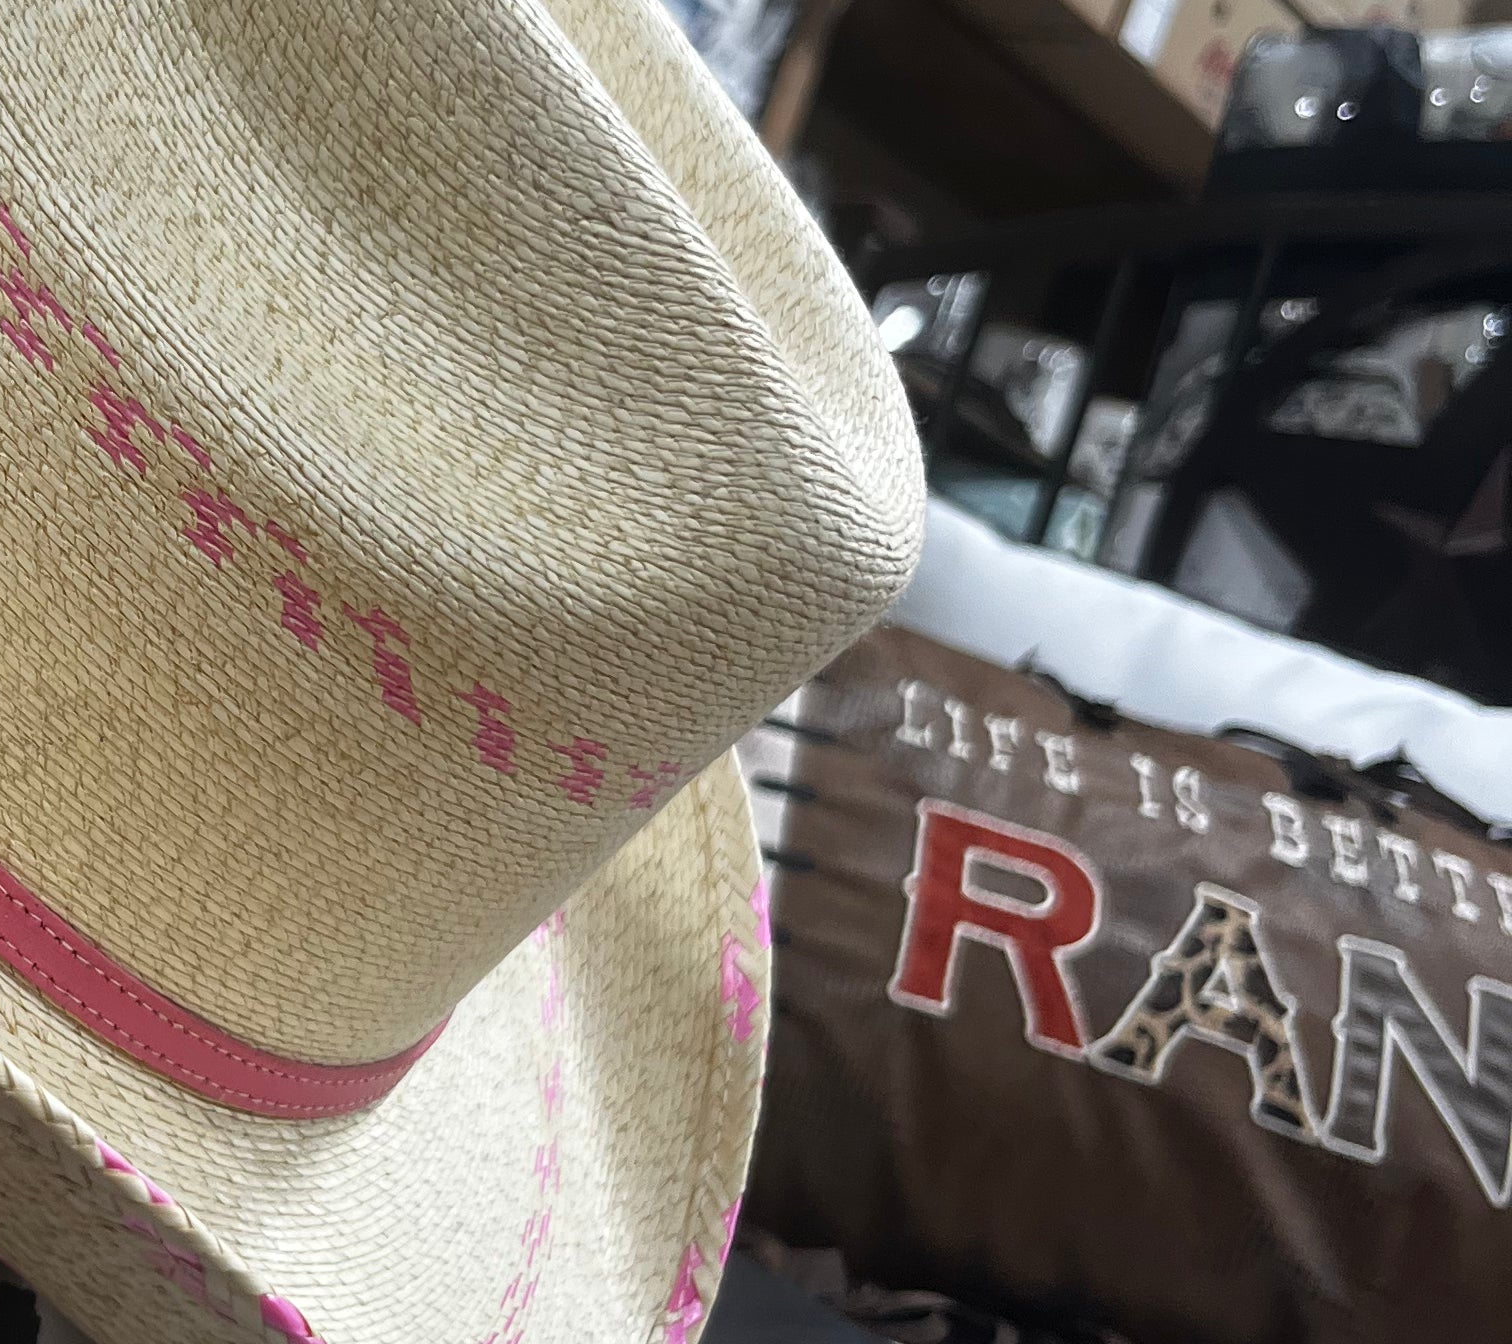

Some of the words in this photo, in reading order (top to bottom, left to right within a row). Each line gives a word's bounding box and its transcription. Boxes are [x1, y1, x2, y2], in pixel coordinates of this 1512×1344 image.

[896, 678, 1081, 795] LIFE
[1130, 752, 1210, 837] IS
[888, 795, 1512, 1210] RAN
